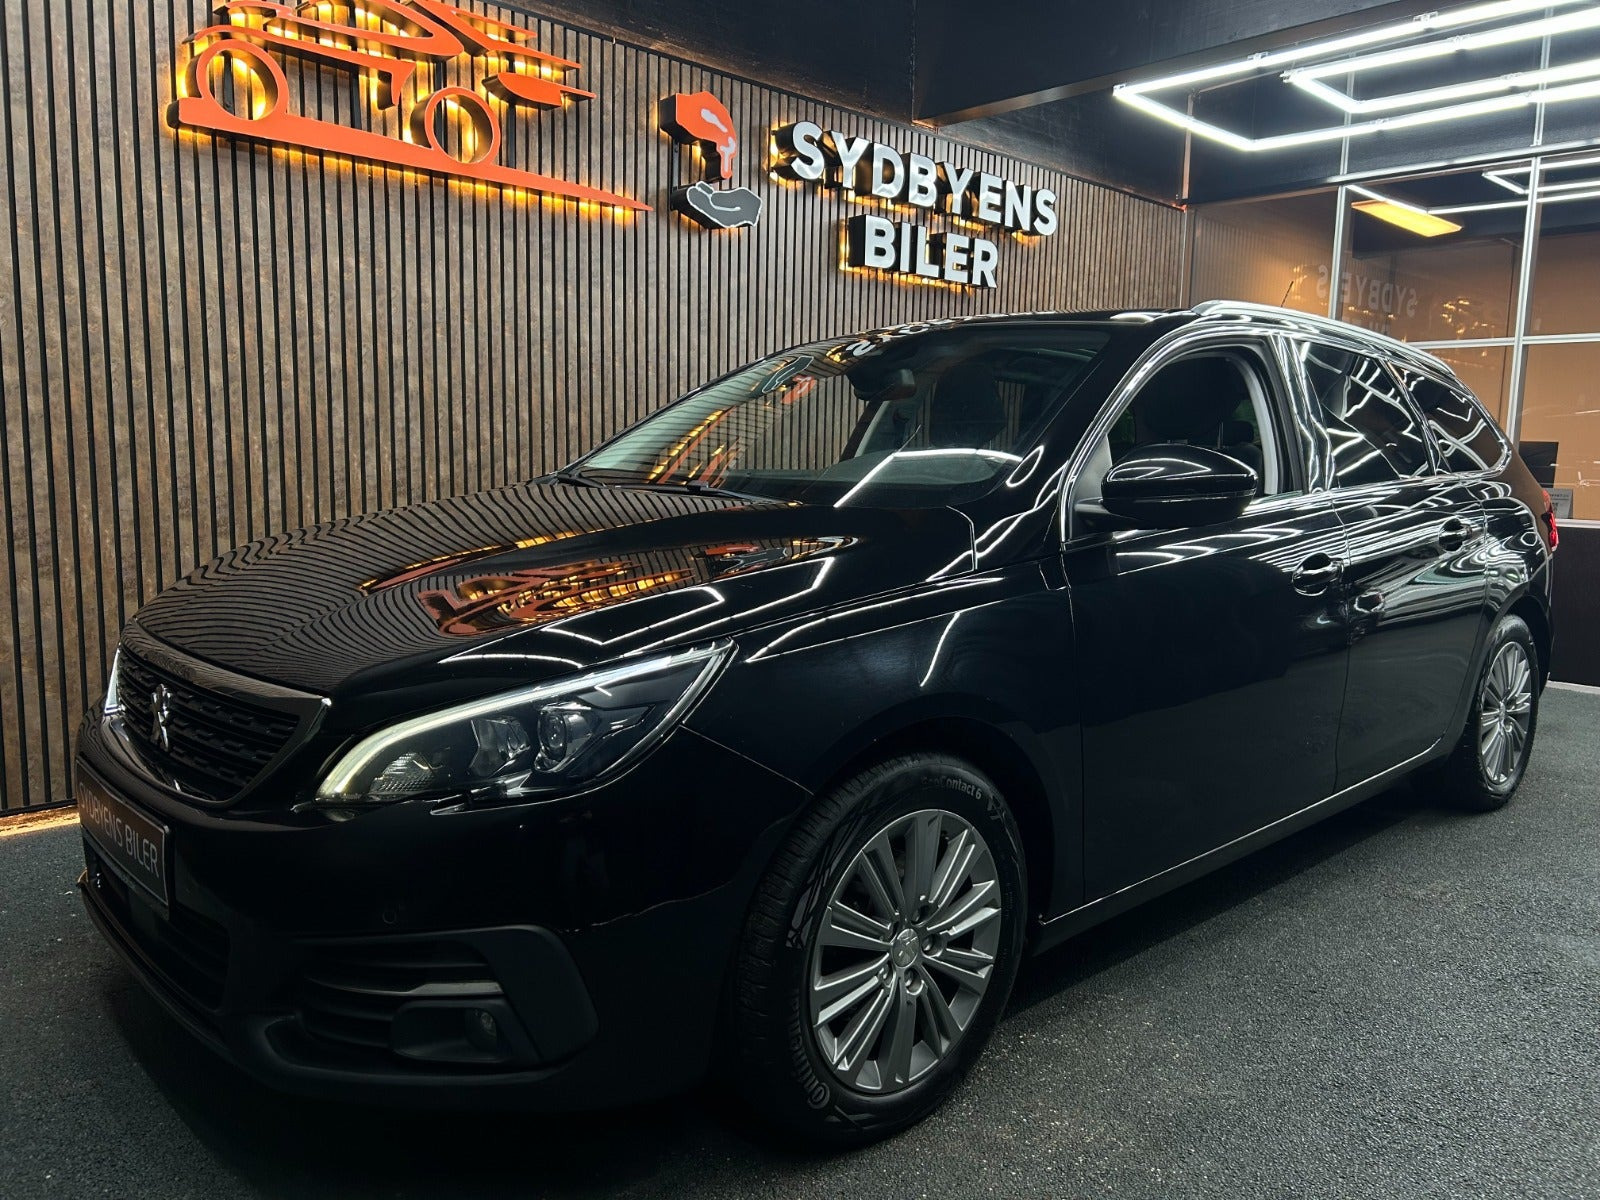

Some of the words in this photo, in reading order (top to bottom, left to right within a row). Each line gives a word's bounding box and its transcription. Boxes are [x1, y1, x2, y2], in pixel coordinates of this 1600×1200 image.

[790, 120, 1058, 237] SYDBYENS
[863, 214, 999, 289] BILER
[79, 781, 123, 847] SYDBYENS
[124, 823, 160, 879] BILER
[975, 787, 982, 800] 6
